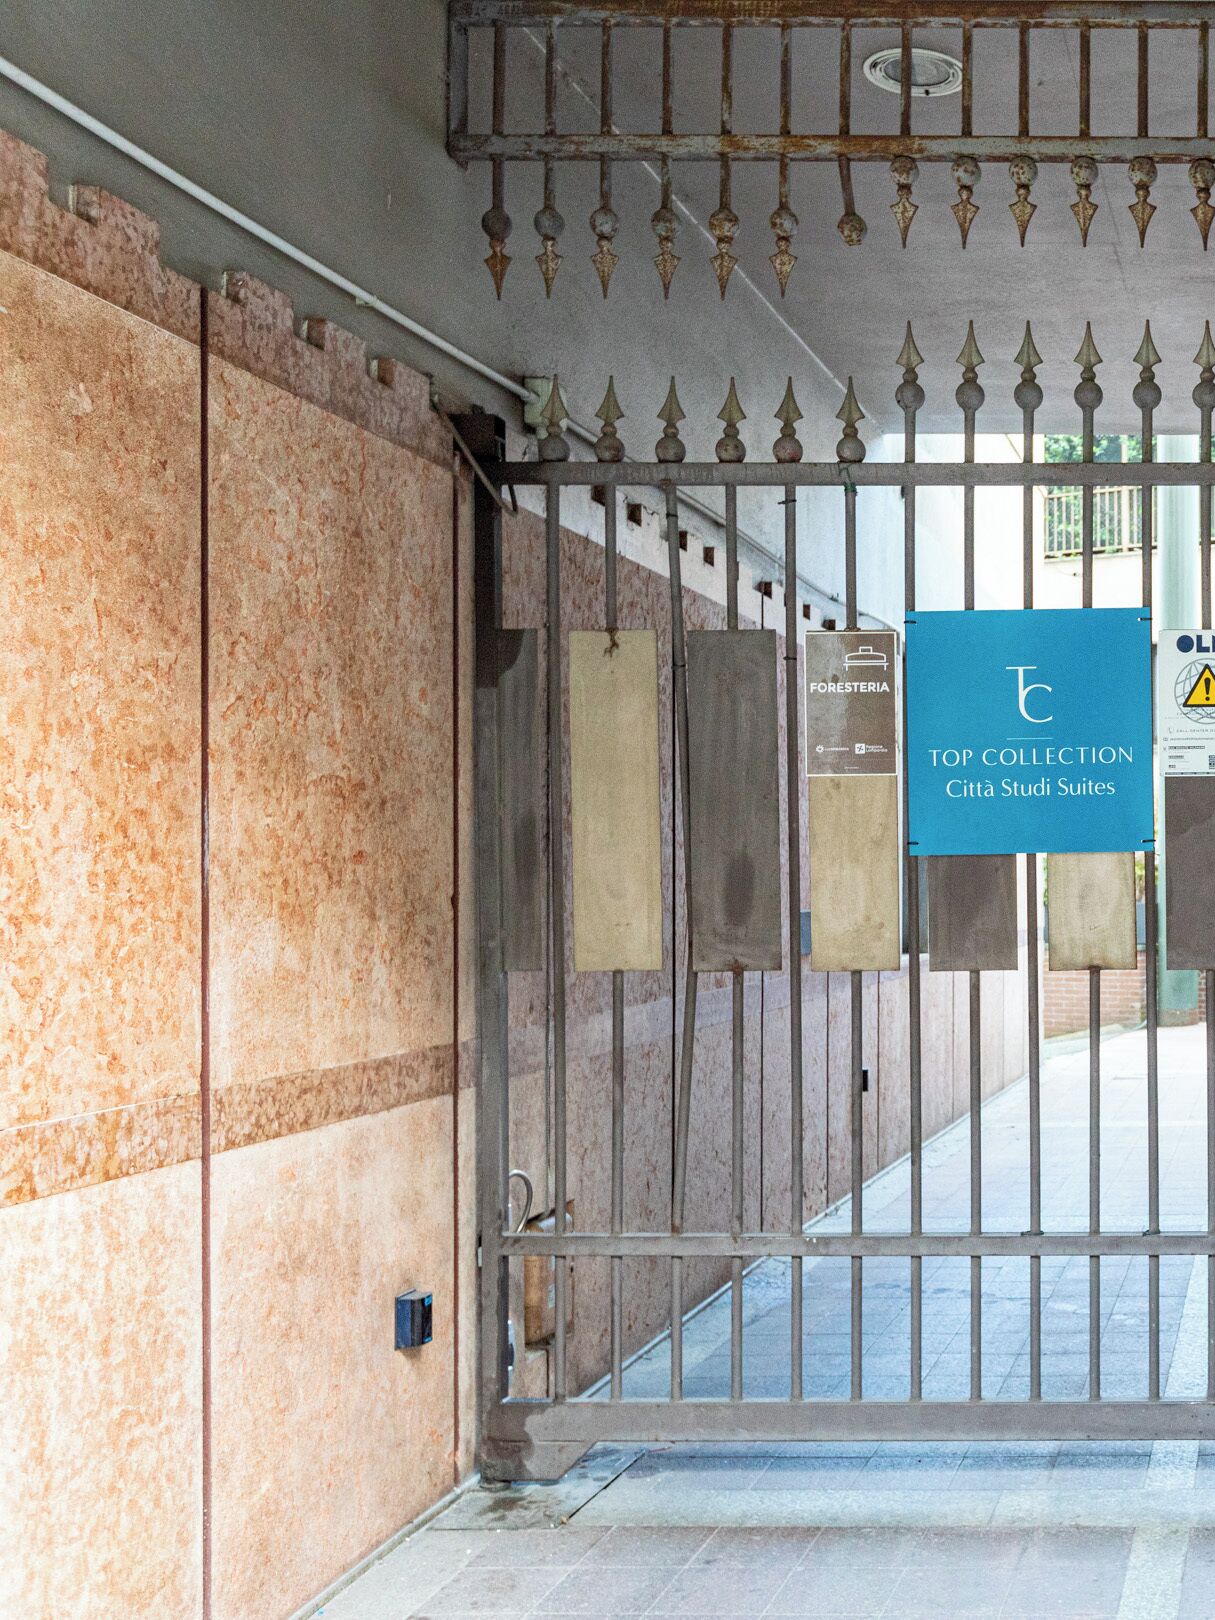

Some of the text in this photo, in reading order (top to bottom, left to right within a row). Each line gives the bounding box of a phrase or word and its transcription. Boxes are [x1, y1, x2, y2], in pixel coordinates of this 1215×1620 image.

[810, 681, 890, 693] FORESTERIA
[928, 746, 1133, 767] TOP COLLECTION
[946, 777, 1116, 798] Città Studi Suites
